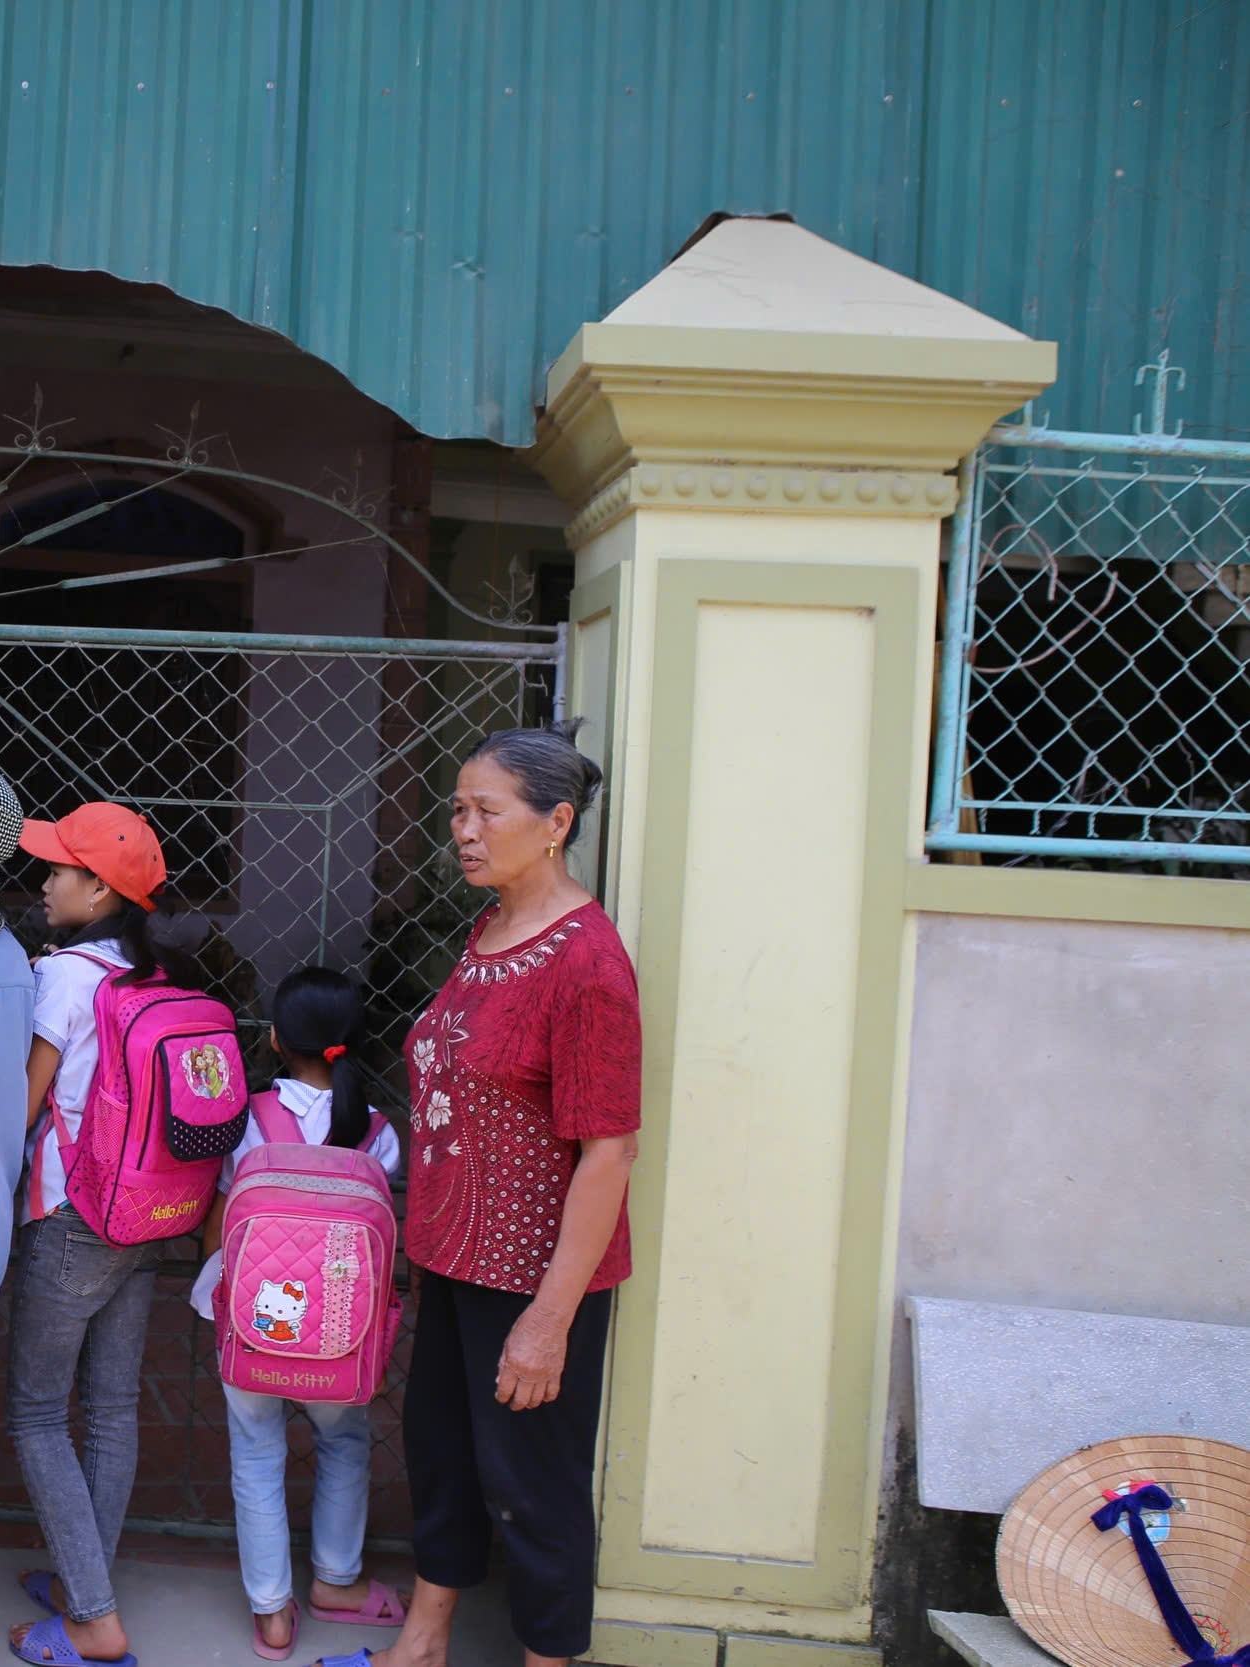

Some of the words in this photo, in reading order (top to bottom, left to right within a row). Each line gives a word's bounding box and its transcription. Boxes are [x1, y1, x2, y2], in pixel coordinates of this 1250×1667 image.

[151, 1205, 176, 1220] Hello
[251, 1368, 290, 1386] Hello
[293, 1373, 336, 1389] Kitty
